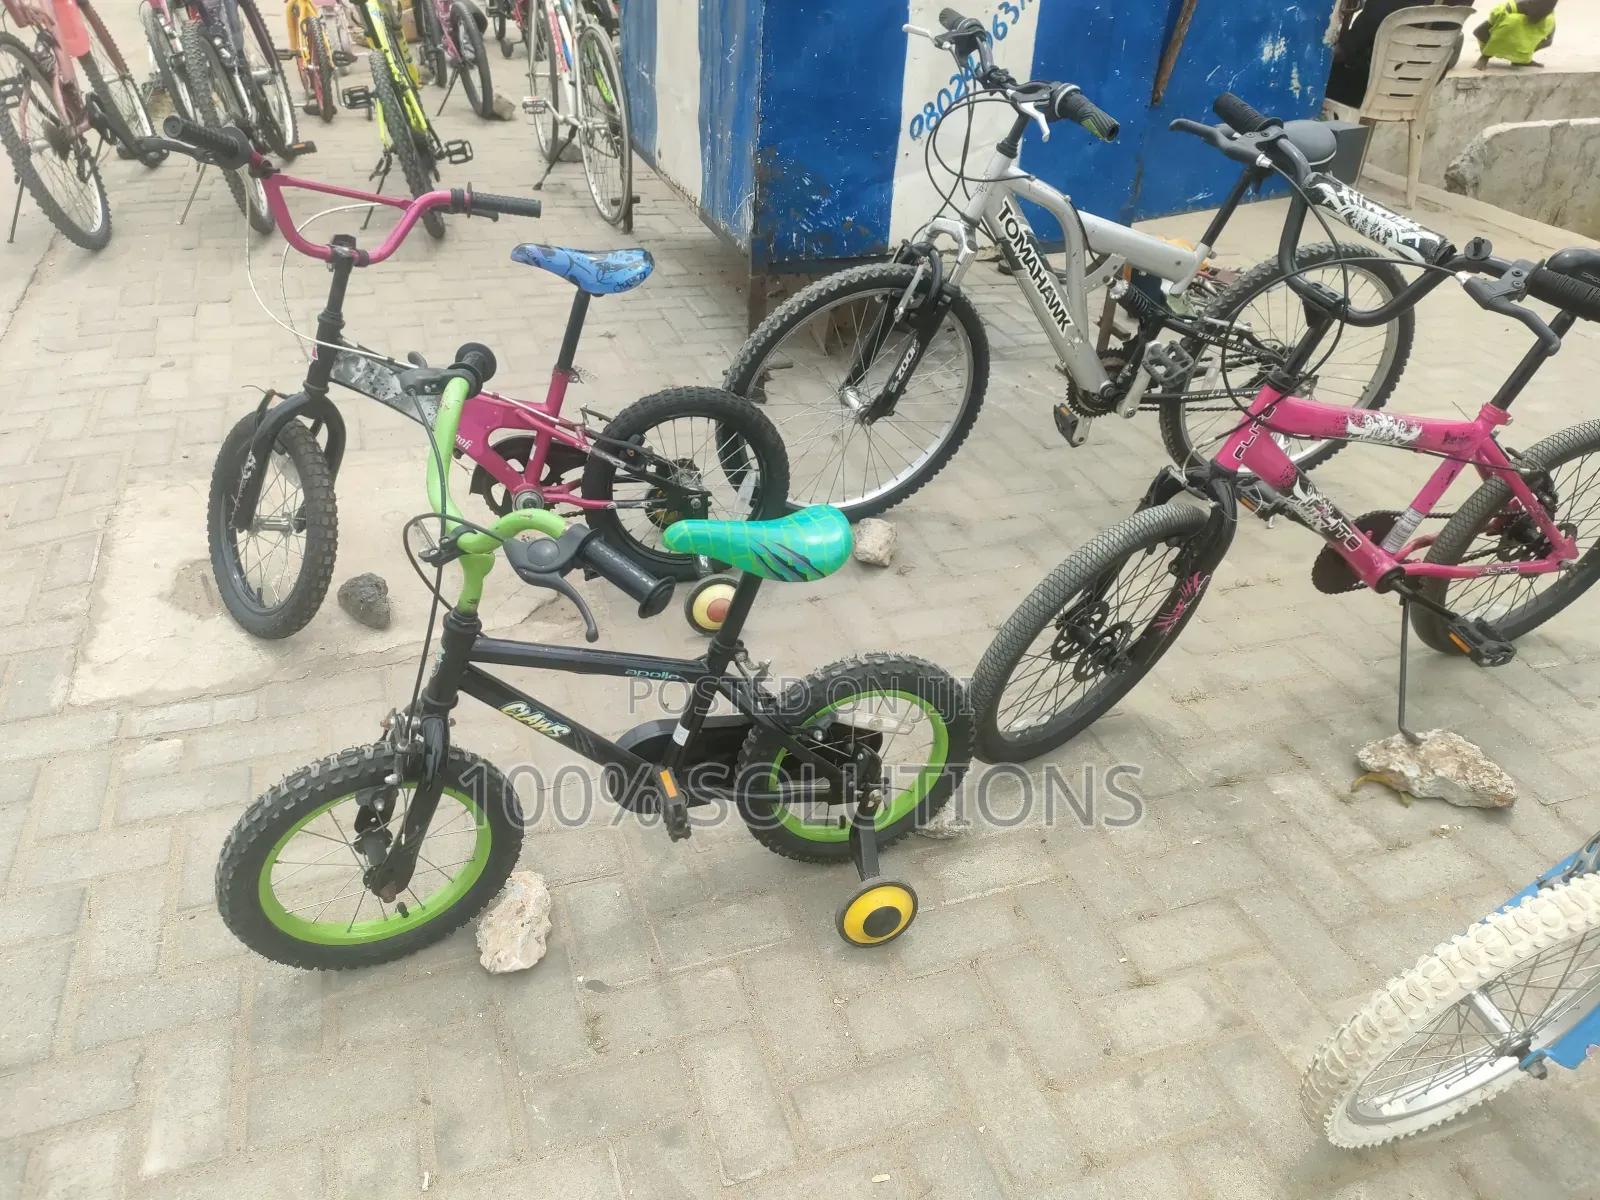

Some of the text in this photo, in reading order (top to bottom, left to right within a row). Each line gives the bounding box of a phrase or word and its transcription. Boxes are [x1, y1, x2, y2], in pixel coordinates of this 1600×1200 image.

[997, 200, 1072, 334] TOMAHAWK
[625, 668, 681, 682] apollo
[501, 700, 571, 738] CLAWS
